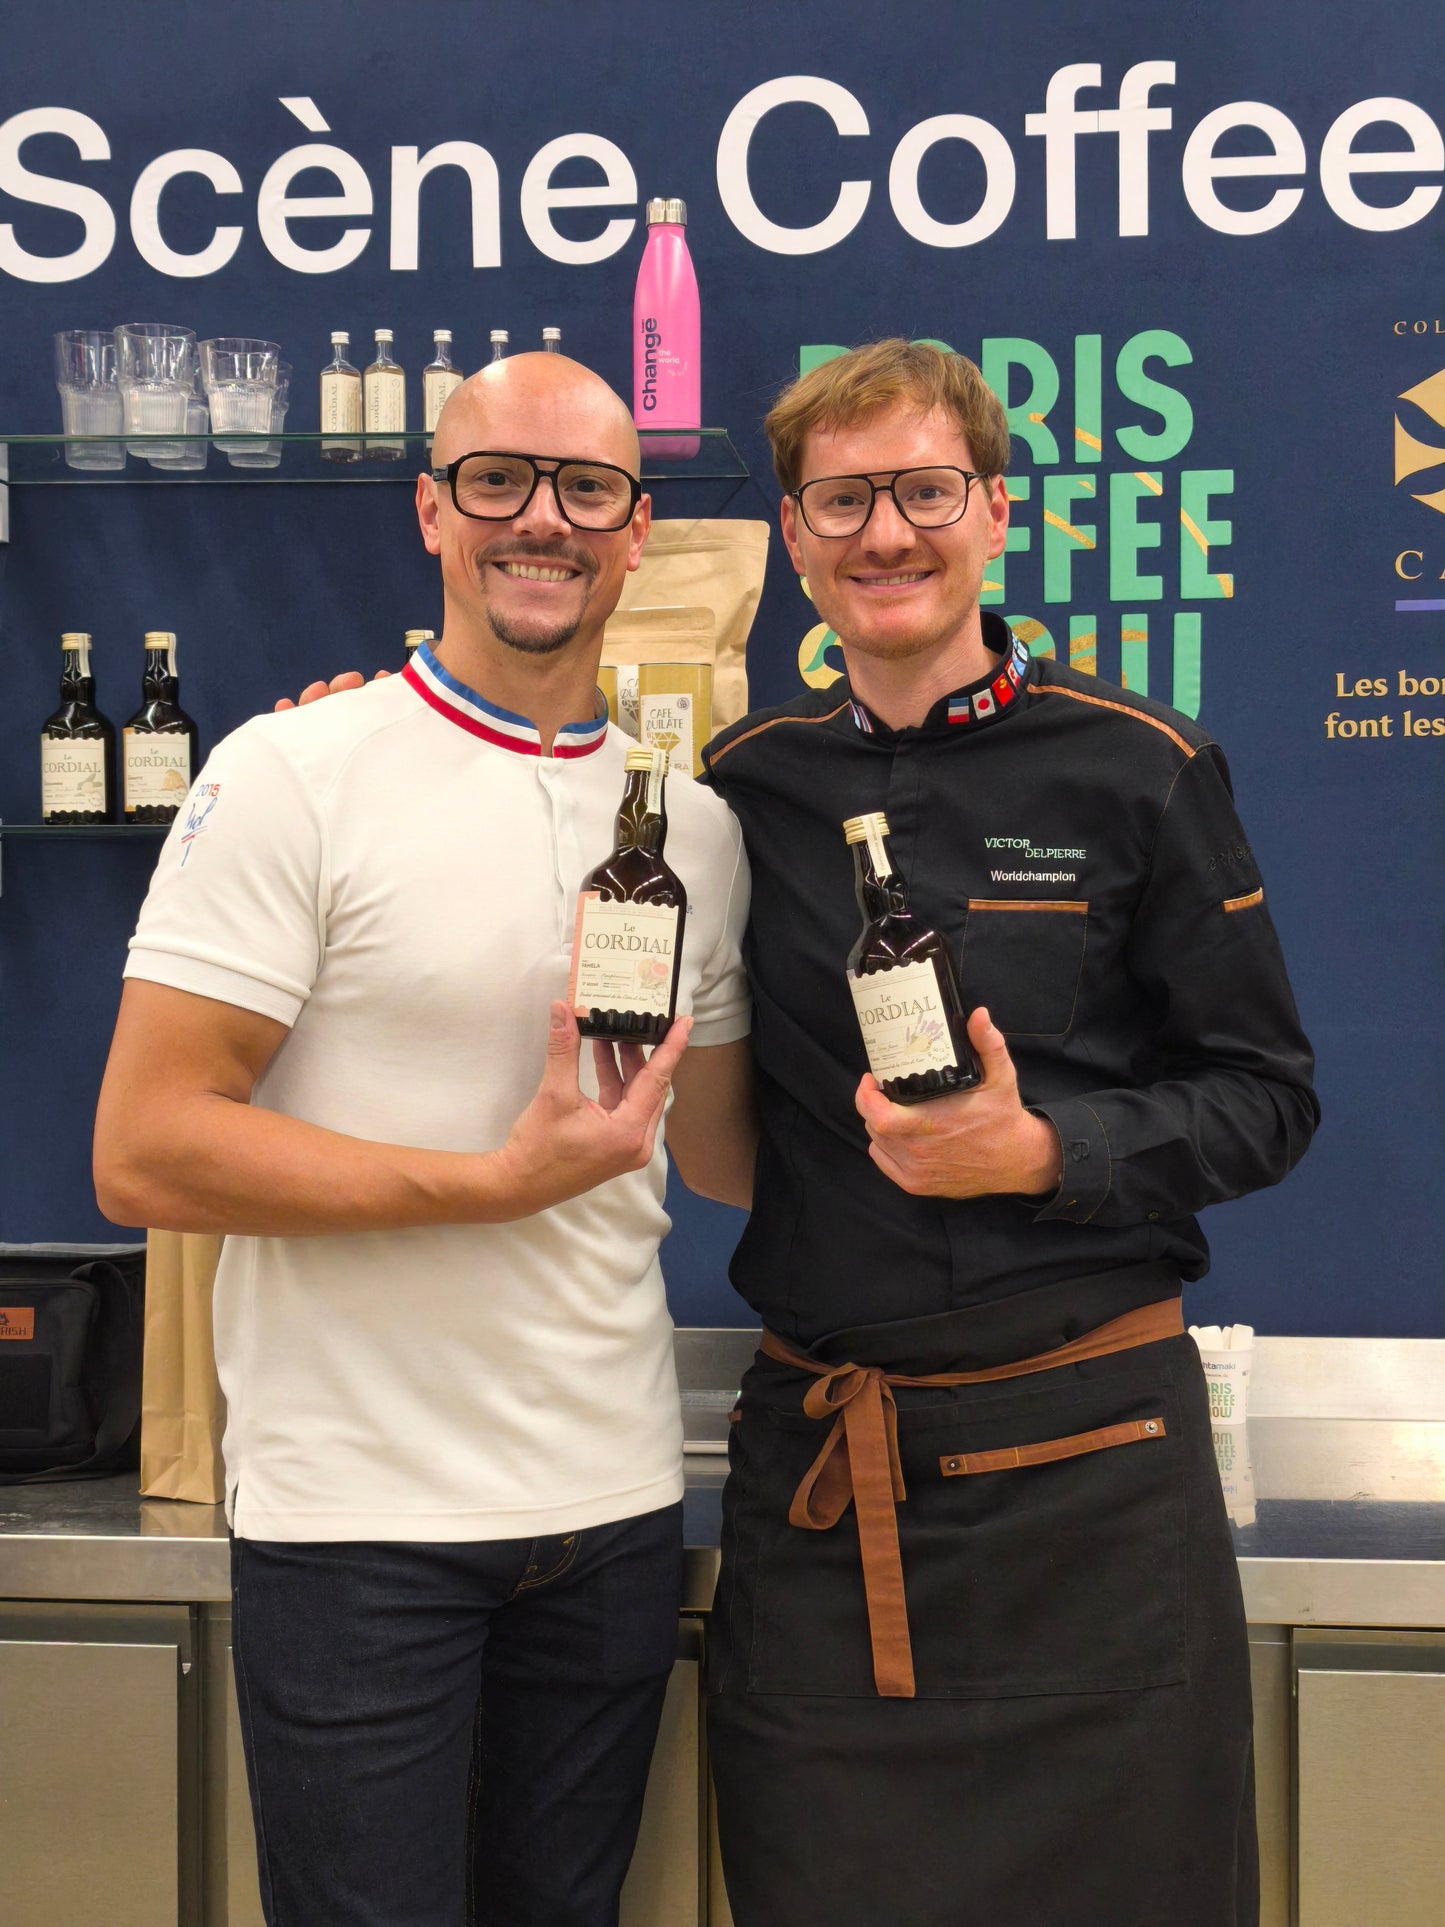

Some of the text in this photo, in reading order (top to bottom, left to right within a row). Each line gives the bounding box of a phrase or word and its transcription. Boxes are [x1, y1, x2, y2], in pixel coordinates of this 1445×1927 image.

[0, 60, 1445, 283] Scène Coffee
[642, 317, 662, 412] Change
[439, 382, 447, 408] DIAL
[800, 330, 1194, 465] RIS
[1394, 550, 1445, 580] C
[1335, 669, 1445, 698] Les bo
[1324, 710, 1445, 739] font les
[43, 761, 101, 773] CORDIAL
[128, 756, 187, 768] CORDIAL
[195, 784, 222, 798] 2015
[984, 837, 1031, 850] VICTOR
[1025, 848, 1087, 860] DELPIERRE
[990, 870, 1076, 882] Worldchampion
[623, 922, 636, 932] Le
[585, 933, 672, 956] CORDIAL
[880, 994, 891, 1003] Le
[858, 995, 937, 1027] CORDIAL
[1206, 1382, 1232, 1394] RIS
[1208, 1394, 1236, 1406] FFEE
